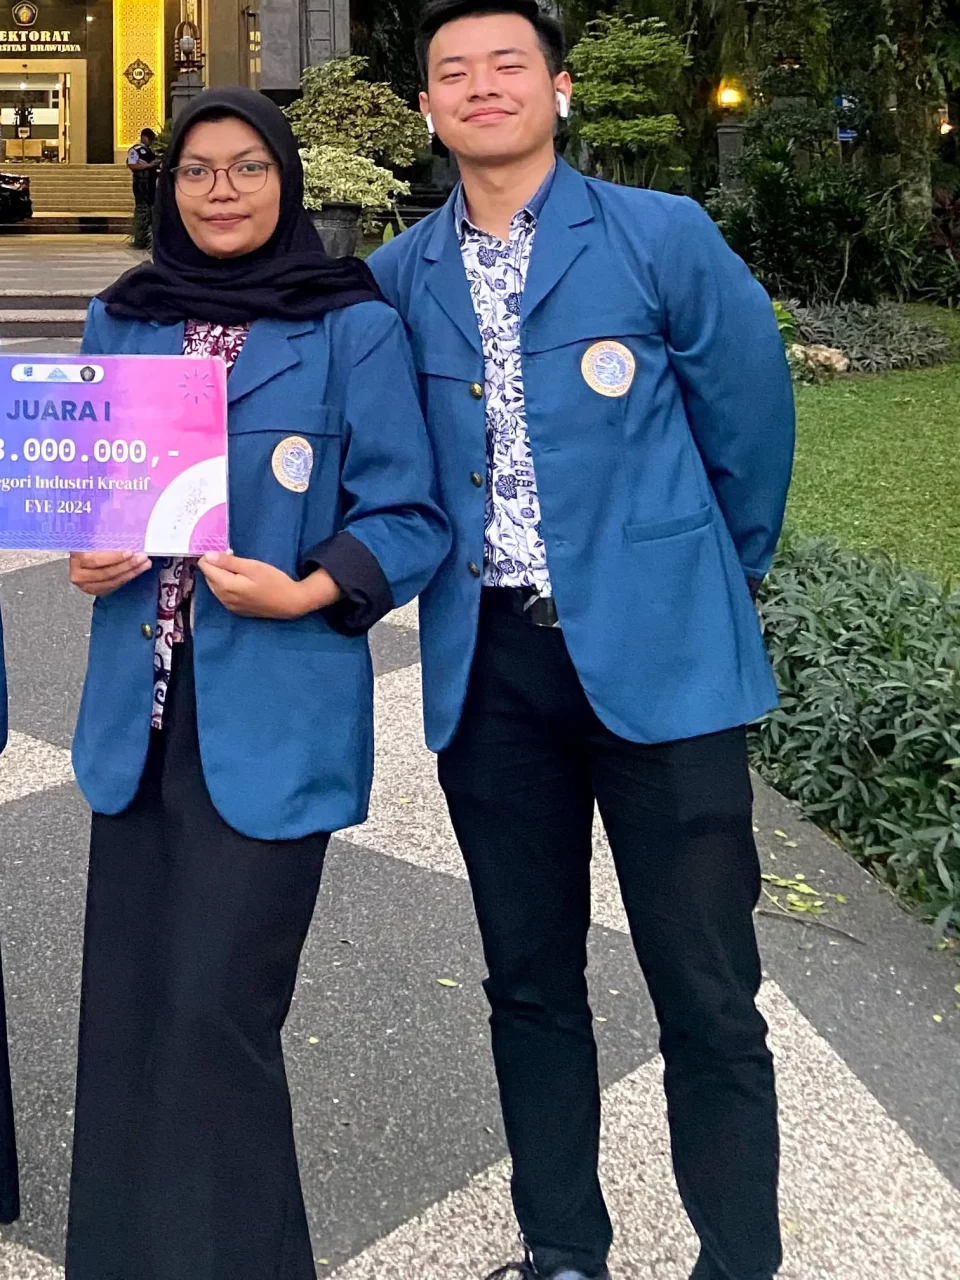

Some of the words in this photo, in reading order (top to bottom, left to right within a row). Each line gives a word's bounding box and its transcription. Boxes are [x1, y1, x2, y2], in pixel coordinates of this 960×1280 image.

[30, 44, 81, 52] BRAWIJAYA
[6, 399, 97, 421] JUARA
[35, 475, 94, 490] Industri
[97, 475, 151, 491] Kreatif
[24, 499, 53, 513] EYE
[57, 500, 92, 514] 2024
